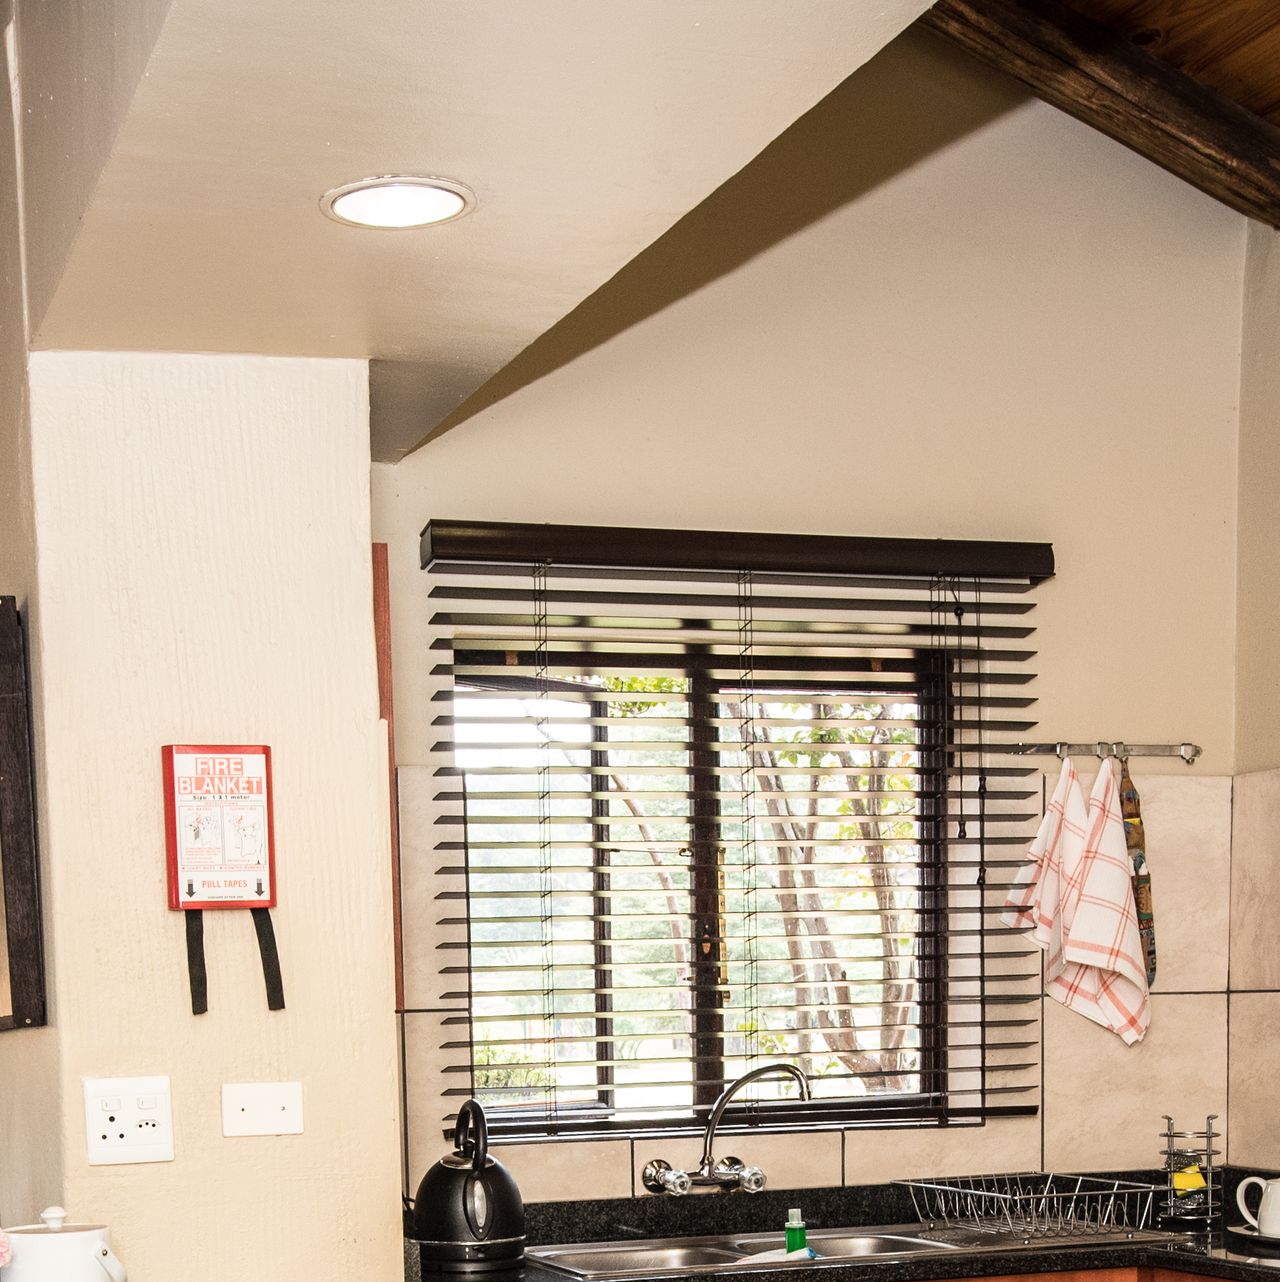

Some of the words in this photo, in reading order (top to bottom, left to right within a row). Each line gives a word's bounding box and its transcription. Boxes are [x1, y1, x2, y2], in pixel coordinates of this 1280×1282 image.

[197, 758, 242, 775] FIRE
[179, 777, 261, 794] BLANKET
[202, 880, 221, 888] PULL
[224, 880, 248, 888] TAPES
